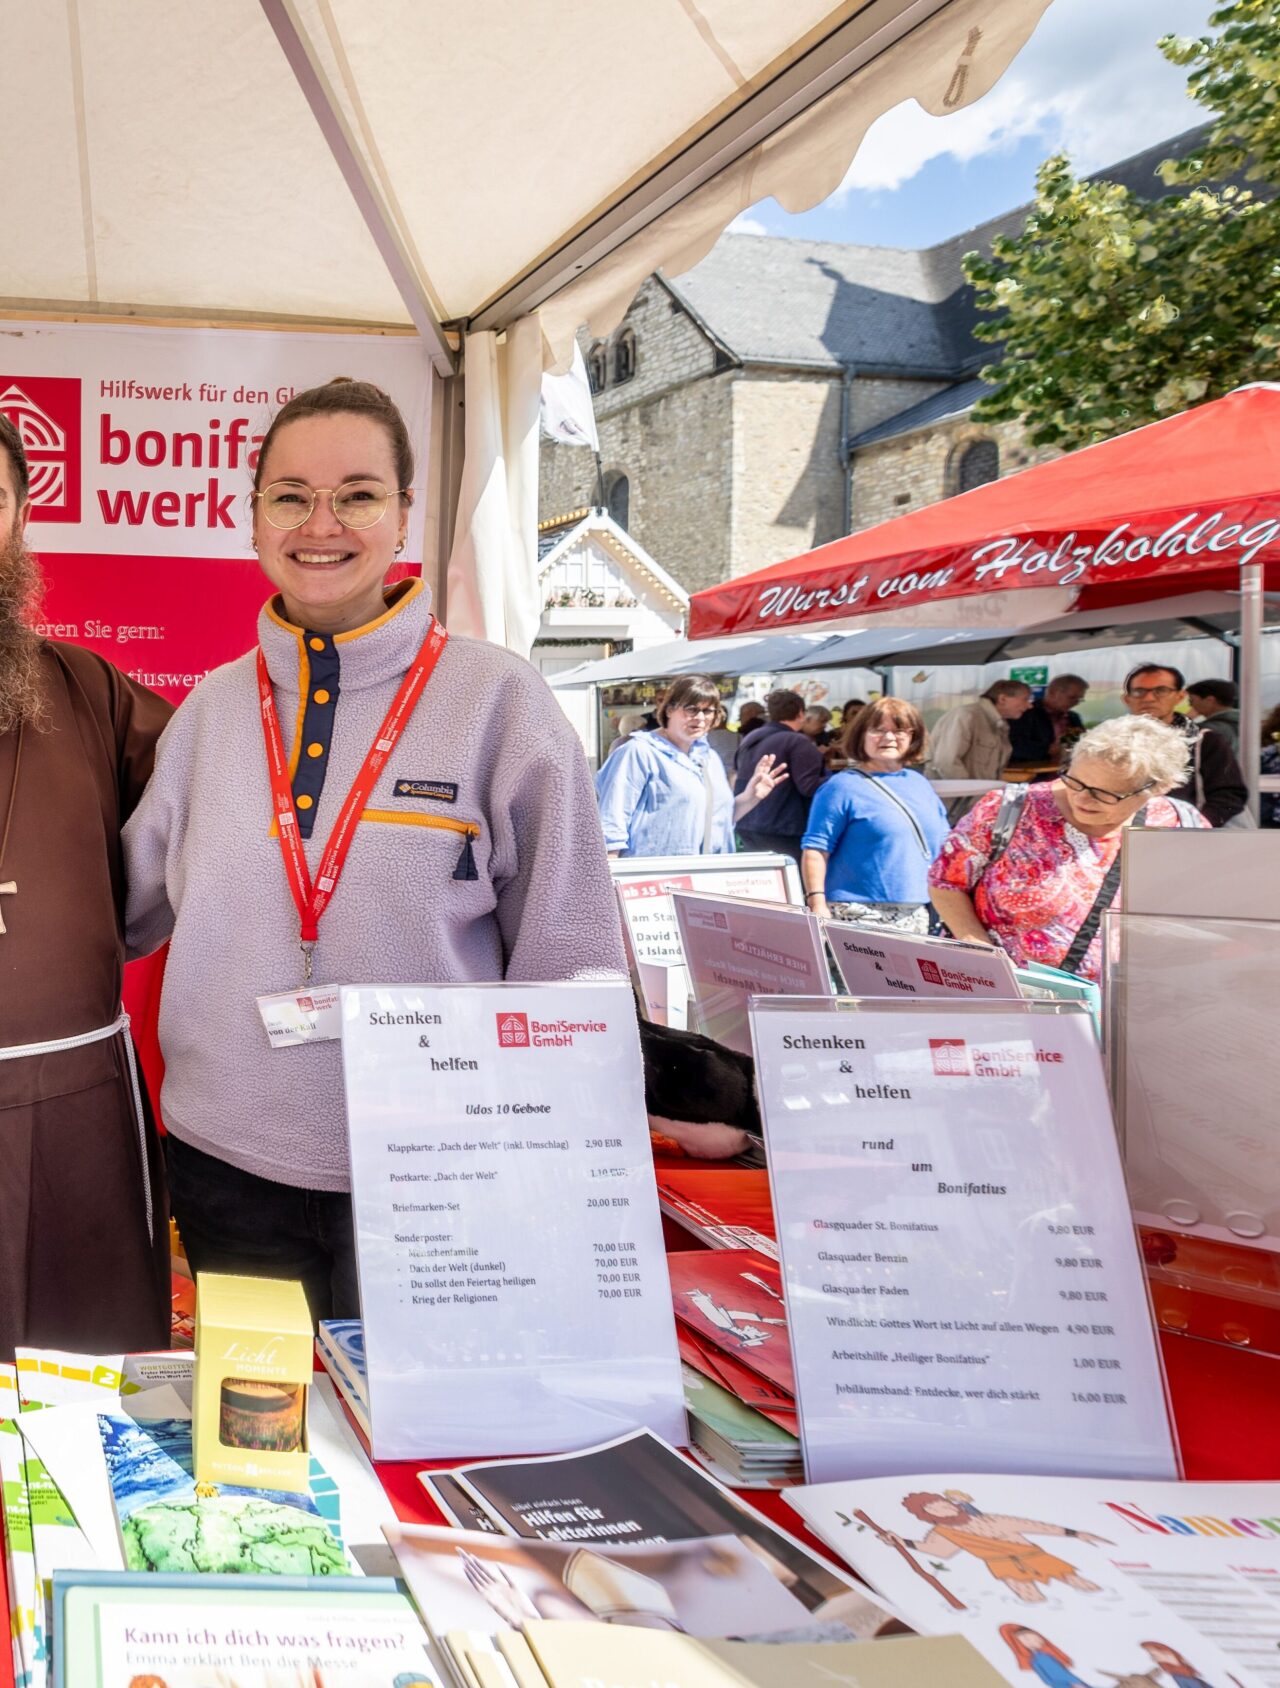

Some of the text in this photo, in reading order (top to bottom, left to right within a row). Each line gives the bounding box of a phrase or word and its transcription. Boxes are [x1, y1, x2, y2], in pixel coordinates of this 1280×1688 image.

[99, 380, 269, 405] Hilfswerk für den
[97, 478, 237, 529] werk
[759, 577, 868, 618] Wurst
[877, 565, 954, 600] vom
[84, 620, 165, 644] Sie gern:
[411, 783, 454, 795] Columbia
[624, 886, 657, 897] ab 15
[636, 932, 670, 941] David
[844, 942, 886, 958] Schenken
[875, 962, 883, 971] &
[886, 977, 916, 992] helfen
[942, 968, 996, 988] BoniService
[945, 979, 973, 992] GmbH
[369, 1012, 442, 1025] Schenken
[531, 1020, 607, 1033] BoniService
[418, 1035, 431, 1048] &
[532, 1034, 573, 1047] GmbH
[783, 1035, 865, 1050] Schenken
[972, 1049, 1064, 1063] BoniService
[430, 1057, 479, 1071] helfen
[839, 1060, 854, 1073] &
[974, 1063, 1022, 1077] GmbH
[854, 1084, 911, 1100] helfen
[465, 1103, 551, 1115] Udos 10 Gebote
[387, 1139, 622, 1154] Klappkarte: der (inkl. Umschlag) 2,90 EUR
[862, 1138, 894, 1150] rund
[911, 1161, 933, 1172] um
[390, 1171, 474, 1182] Postkarte: der
[937, 1182, 1007, 1196] Bonifatius
[392, 1198, 630, 1213] Briefmarken-Set 20,00 EUR
[875, 1221, 1095, 1236] St. Bonifatius EUR
[593, 1242, 636, 1253] 70,00 EUR
[410, 1257, 638, 1273] Dach der Welt (dunkel) 70,00 EUR
[818, 1252, 1103, 1268] Glasquader Benzin 9,80 EUR
[410, 1273, 641, 1289] Du sollst den Feiertag heiligen 70,00 EUR
[412, 1288, 642, 1306] Krieg der Religionen 70,00 EUR
[822, 1284, 1108, 1302] Glasquader Faden 9,80 EUR
[826, 1317, 1115, 1336] Windlicht: Gottes Wort ist Licht auf allen Wegen 4,90 EUR
[221, 1336, 286, 1364] Licht
[831, 1350, 1122, 1369] Arbeitshilfe 1,00 EUR
[100, 1373, 115, 1385] 2
[965, 1389, 984, 1399] wer
[987, 1389, 1007, 1399] dich
[1009, 1390, 1040, 1400] stärkt
[1072, 1392, 1101, 1403] 16,00
[1104, 1393, 1127, 1404] EUR
[520, 1507, 577, 1528] Hilfen
[574, 1505, 605, 1522] für
[125, 1627, 406, 1654] Kann ich dich was fragen?
[126, 1651, 358, 1671] Emma erklärt Ben die Messe
